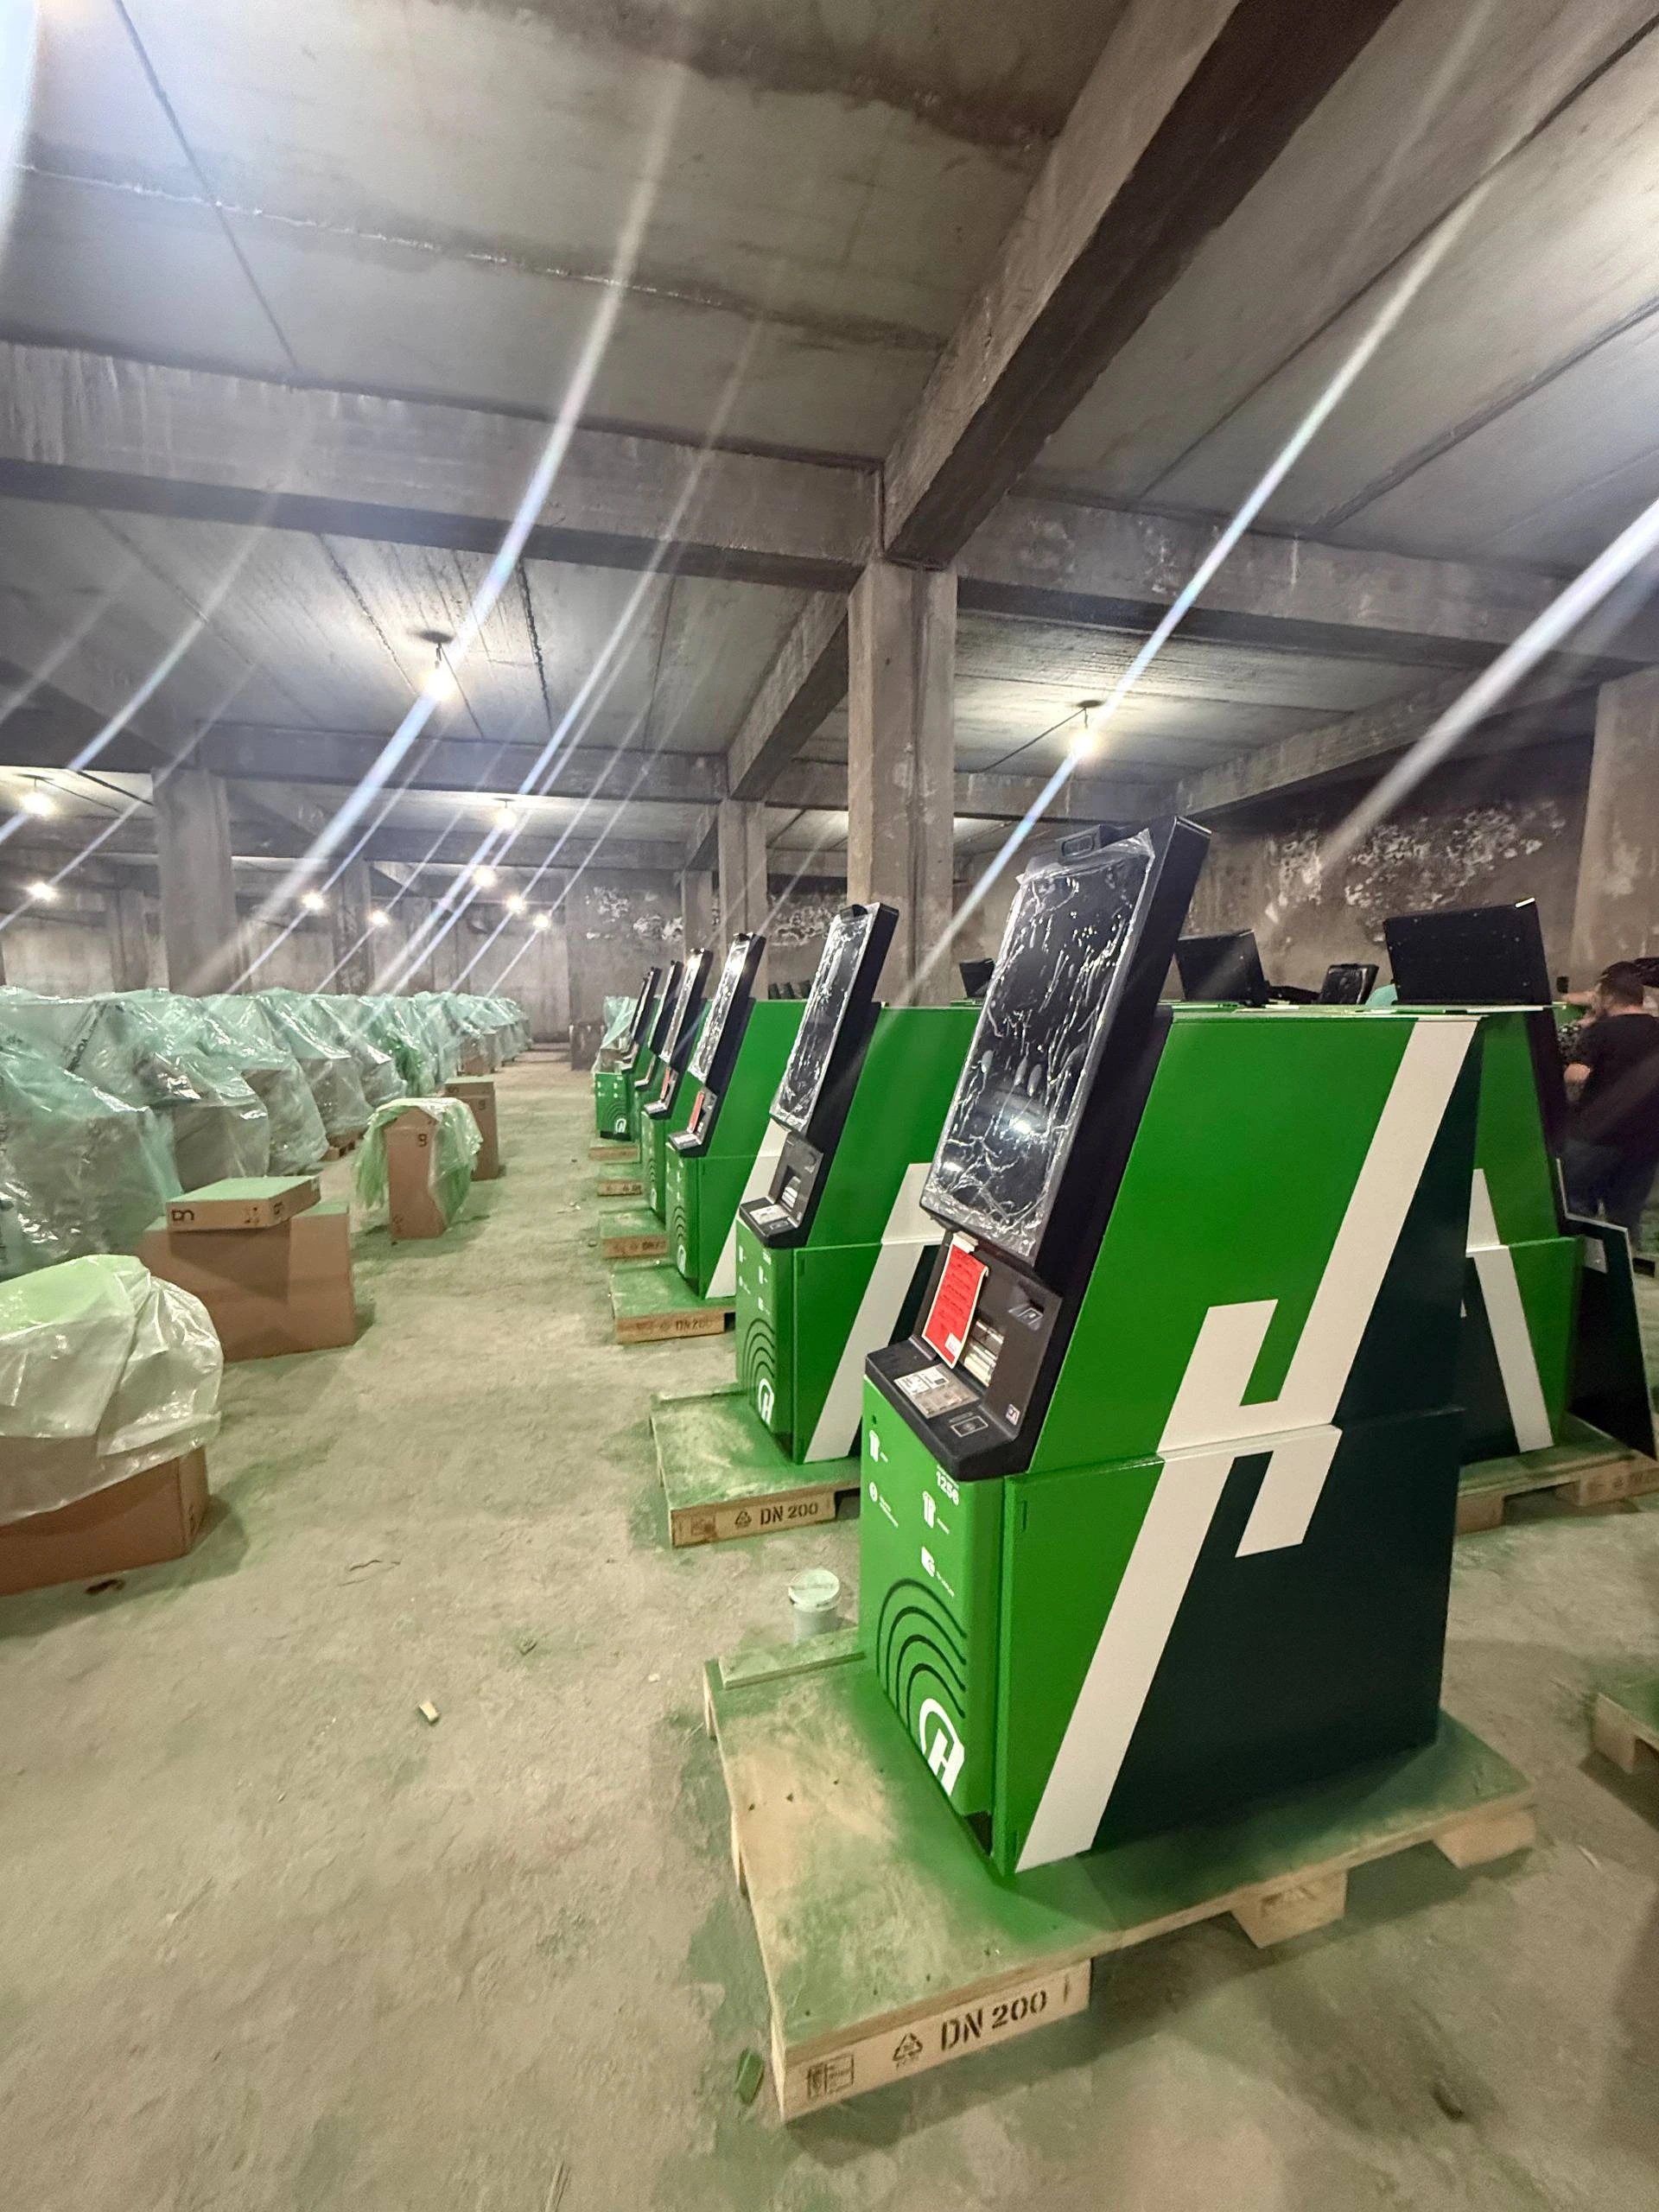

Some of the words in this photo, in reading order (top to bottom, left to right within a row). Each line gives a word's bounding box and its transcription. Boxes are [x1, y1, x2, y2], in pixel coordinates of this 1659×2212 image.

[760, 1505, 784, 1526] DN
[788, 1502, 819, 1519] 200
[941, 2008, 983, 2051] DN
[992, 1990, 1047, 2030] 200
